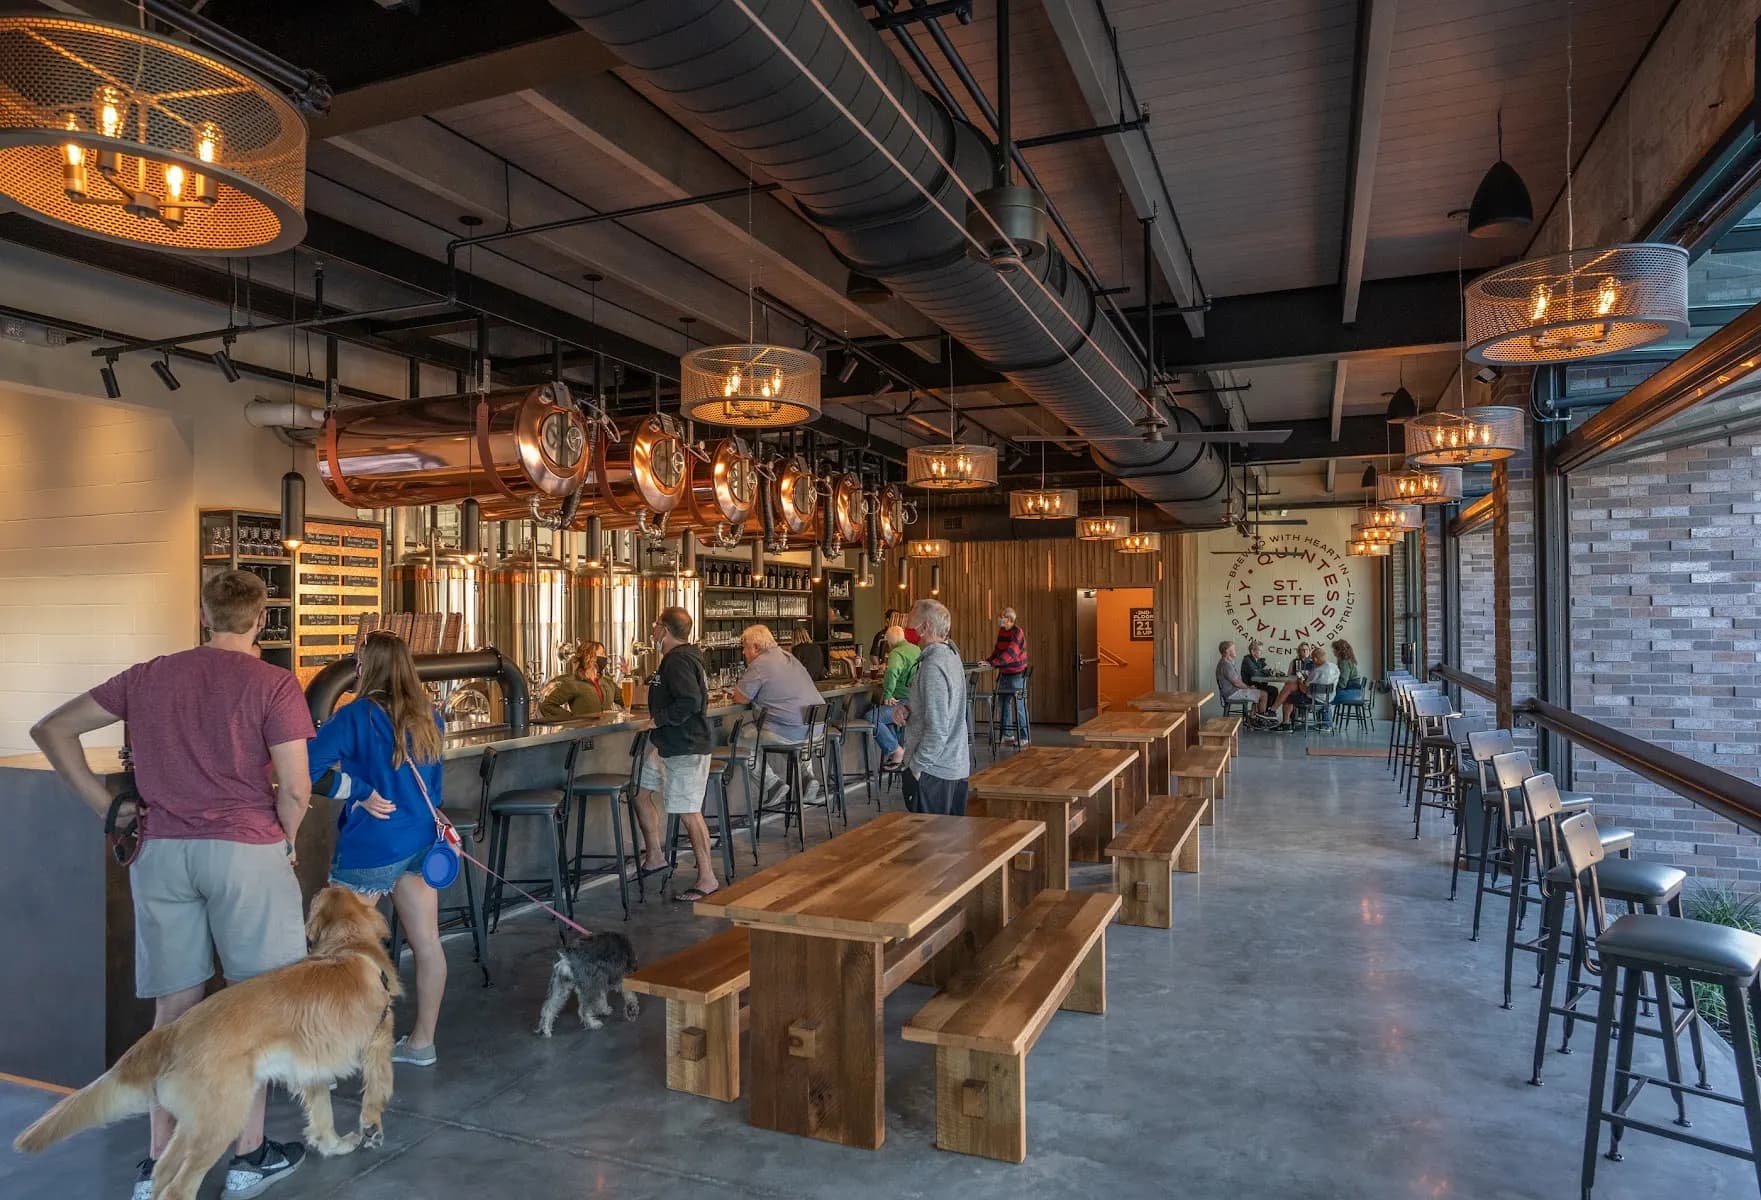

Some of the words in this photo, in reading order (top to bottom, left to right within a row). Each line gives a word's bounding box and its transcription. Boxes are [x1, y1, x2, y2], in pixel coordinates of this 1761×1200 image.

[1229, 540, 1266, 578] BREWD
[1269, 533, 1301, 543] WITH
[1304, 536, 1341, 561] HEART
[1338, 563, 1349, 575] IN
[1238, 546, 1340, 641] QUINTESSENTIALLY
[1273, 579, 1302, 591] ST.
[1262, 594, 1315, 606] PETE
[1136, 621, 1152, 631] 21
[1224, 593, 1234, 616] THE
[1231, 618, 1263, 647] GRAN
[1268, 640, 1325, 655] CENAL
[1326, 591, 1355, 641] DISTRICT
